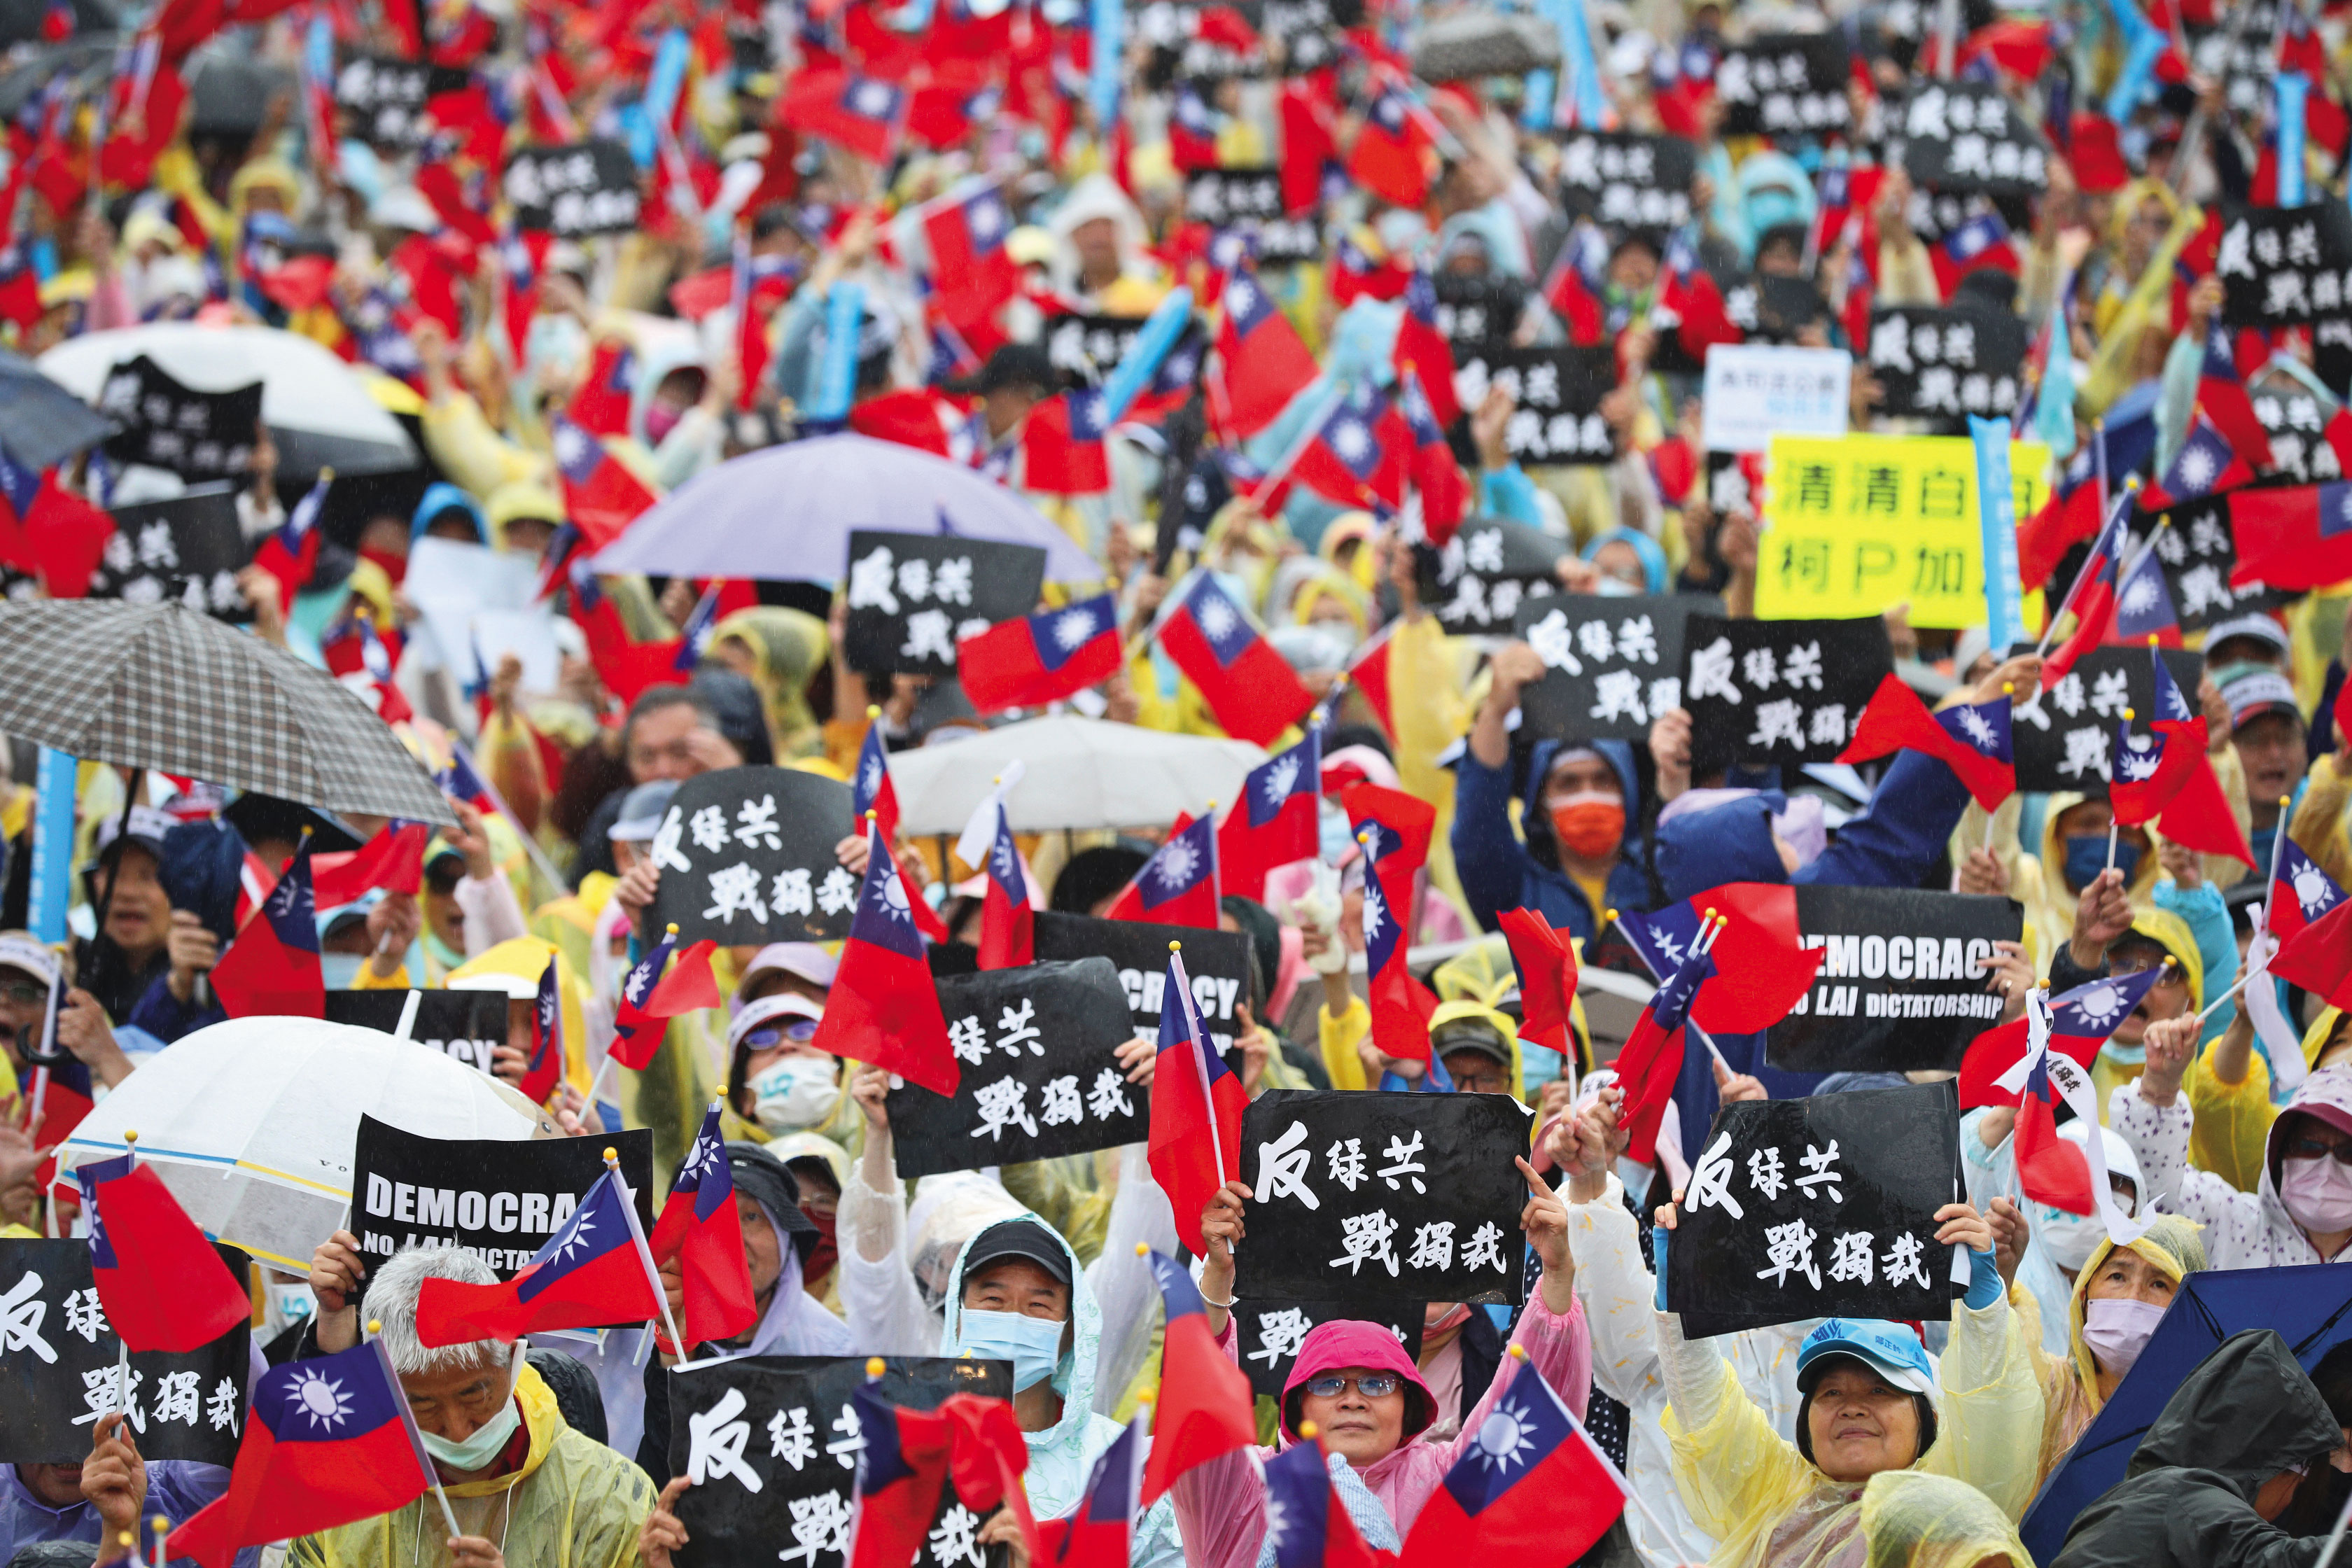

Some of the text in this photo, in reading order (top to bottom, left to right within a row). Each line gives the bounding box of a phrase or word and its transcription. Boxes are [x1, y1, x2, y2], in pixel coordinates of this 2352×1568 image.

[1782, 538, 1987, 595] 柯P加
[1748, 699, 1868, 752] 戰獨
[1118, 968, 1240, 1021] CRCY
[1788, 985, 2004, 1020] O LAI DICTATORSHIP
[425, 1039, 498, 1074] CY
[970, 1068, 1134, 1142] 戰獨裁
[1255, 1120, 1427, 1210] 反綠共
[1685, 1130, 1843, 1220] 反綠共
[365, 1171, 585, 1233] DEMOCRA
[363, 1230, 394, 1256] NO
[1329, 1208, 1506, 1278] 戰獨裁
[1756, 1217, 1931, 1291] 戰獨裁
[71, 1362, 238, 1438] 戰獨裁
[778, 1489, 986, 1568] 戰裁
